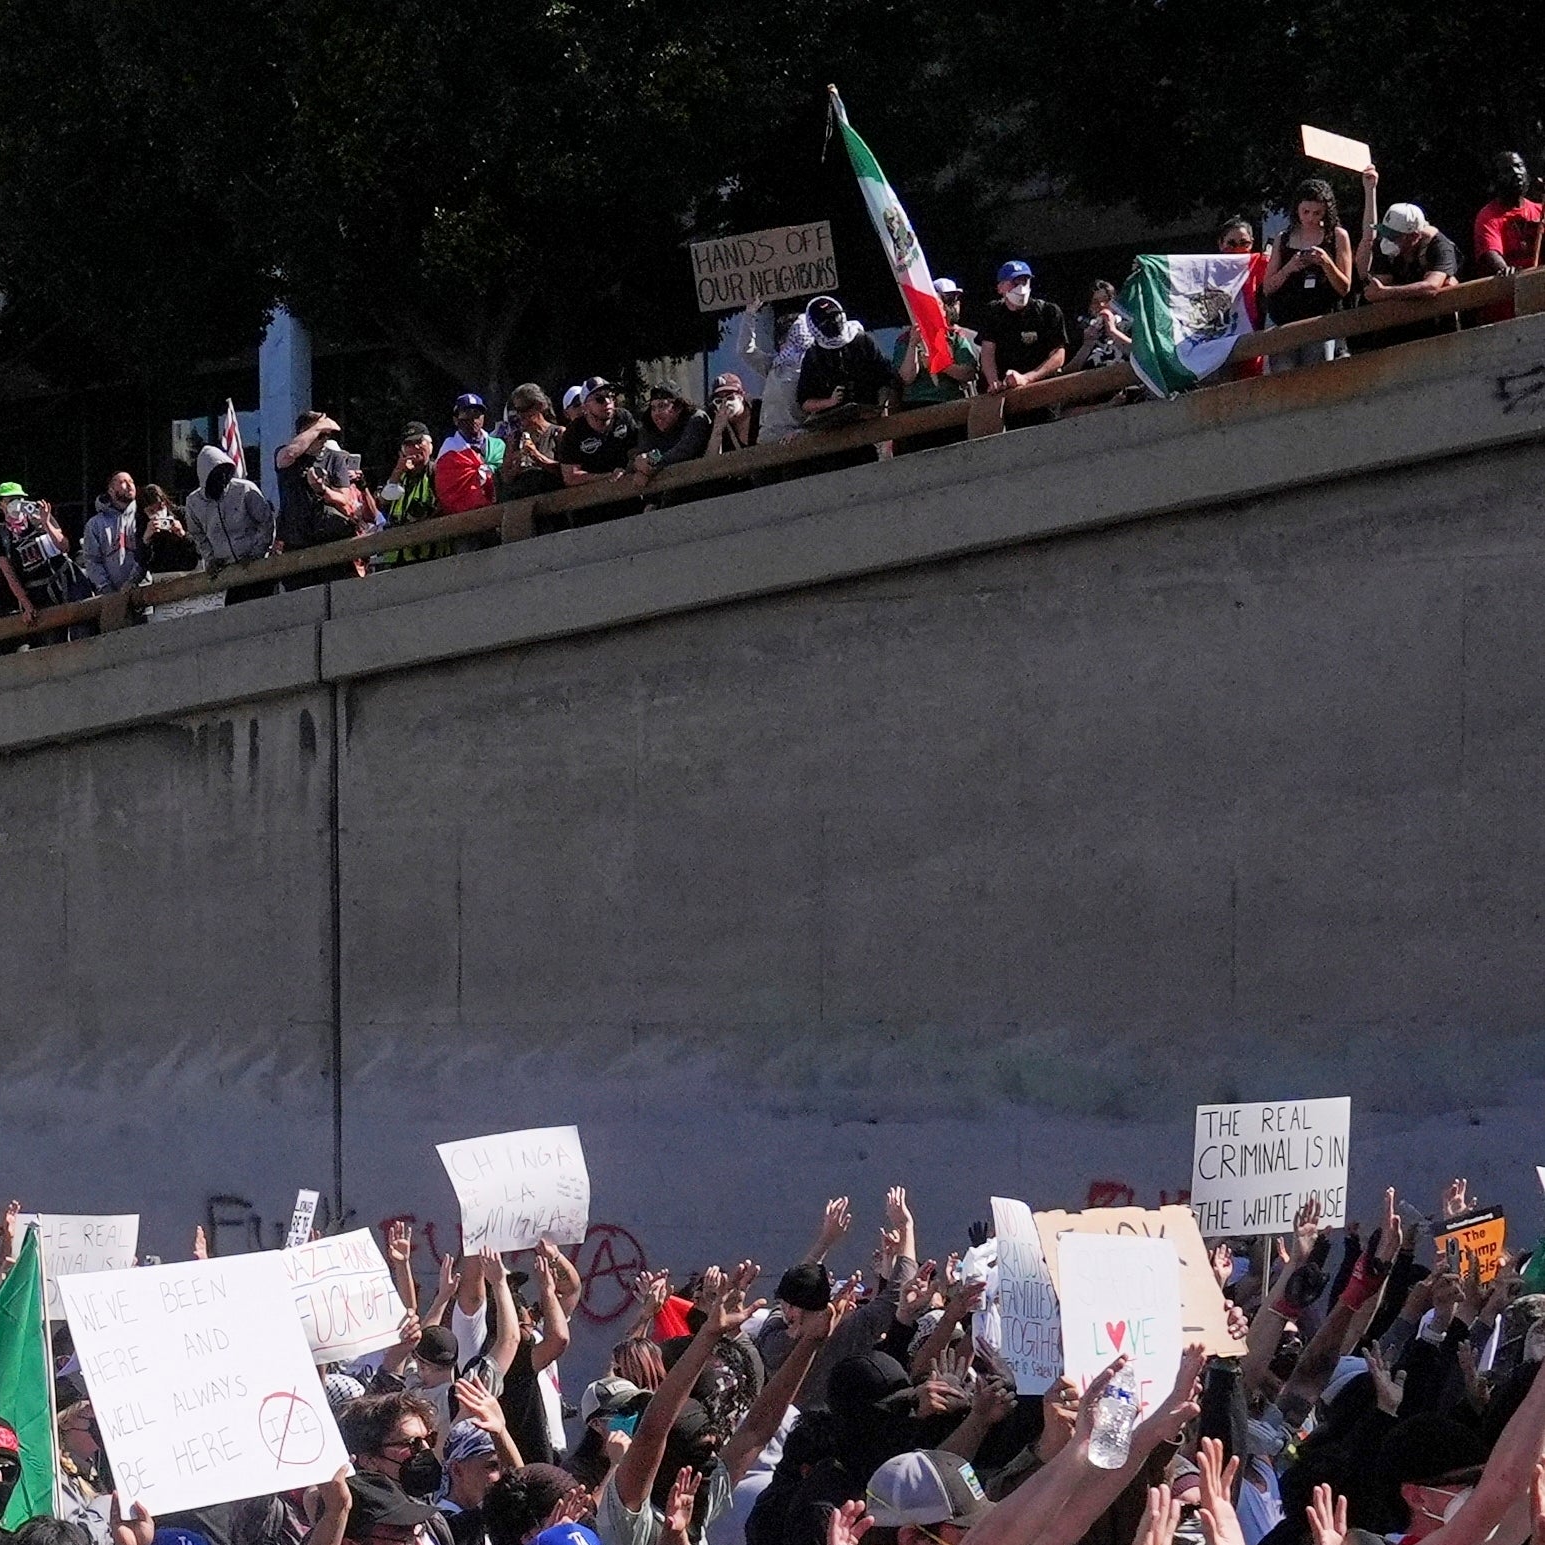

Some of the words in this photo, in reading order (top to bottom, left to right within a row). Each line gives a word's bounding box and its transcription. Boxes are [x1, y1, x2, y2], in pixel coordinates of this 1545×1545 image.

[695, 238, 775, 276] HANDS
[785, 226, 828, 256] OFF
[698, 274, 746, 306] OUR
[749, 256, 837, 297] NEIGHBORS
[1200, 1109, 1240, 1139] THE
[1261, 1104, 1314, 1132] REAL
[451, 1145, 574, 1181] CHINGA
[1197, 1135, 1299, 1181] CRIMINAL
[1304, 1134, 1326, 1172] IS
[1328, 1133, 1345, 1170] IN
[504, 1182, 536, 1202] LA
[1196, 1200, 1238, 1233] THE
[1242, 1193, 1292, 1226] WHITE
[84, 1222, 131, 1249] REAL
[483, 1207, 567, 1241] MIGRA
[1463, 1229, 1486, 1242] The
[69, 1288, 140, 1332] WE'VE
[159, 1272, 228, 1315] BEEN
[295, 1282, 361, 1344] FUCK
[359, 1274, 398, 1321] OFF
[86, 1344, 149, 1385] HERE
[183, 1327, 232, 1358] AND
[172, 1375, 250, 1418] ALWAYS
[264, 1405, 320, 1447] ICE
[117, 1458, 156, 1496] BE
[174, 1426, 244, 1477] HERE
